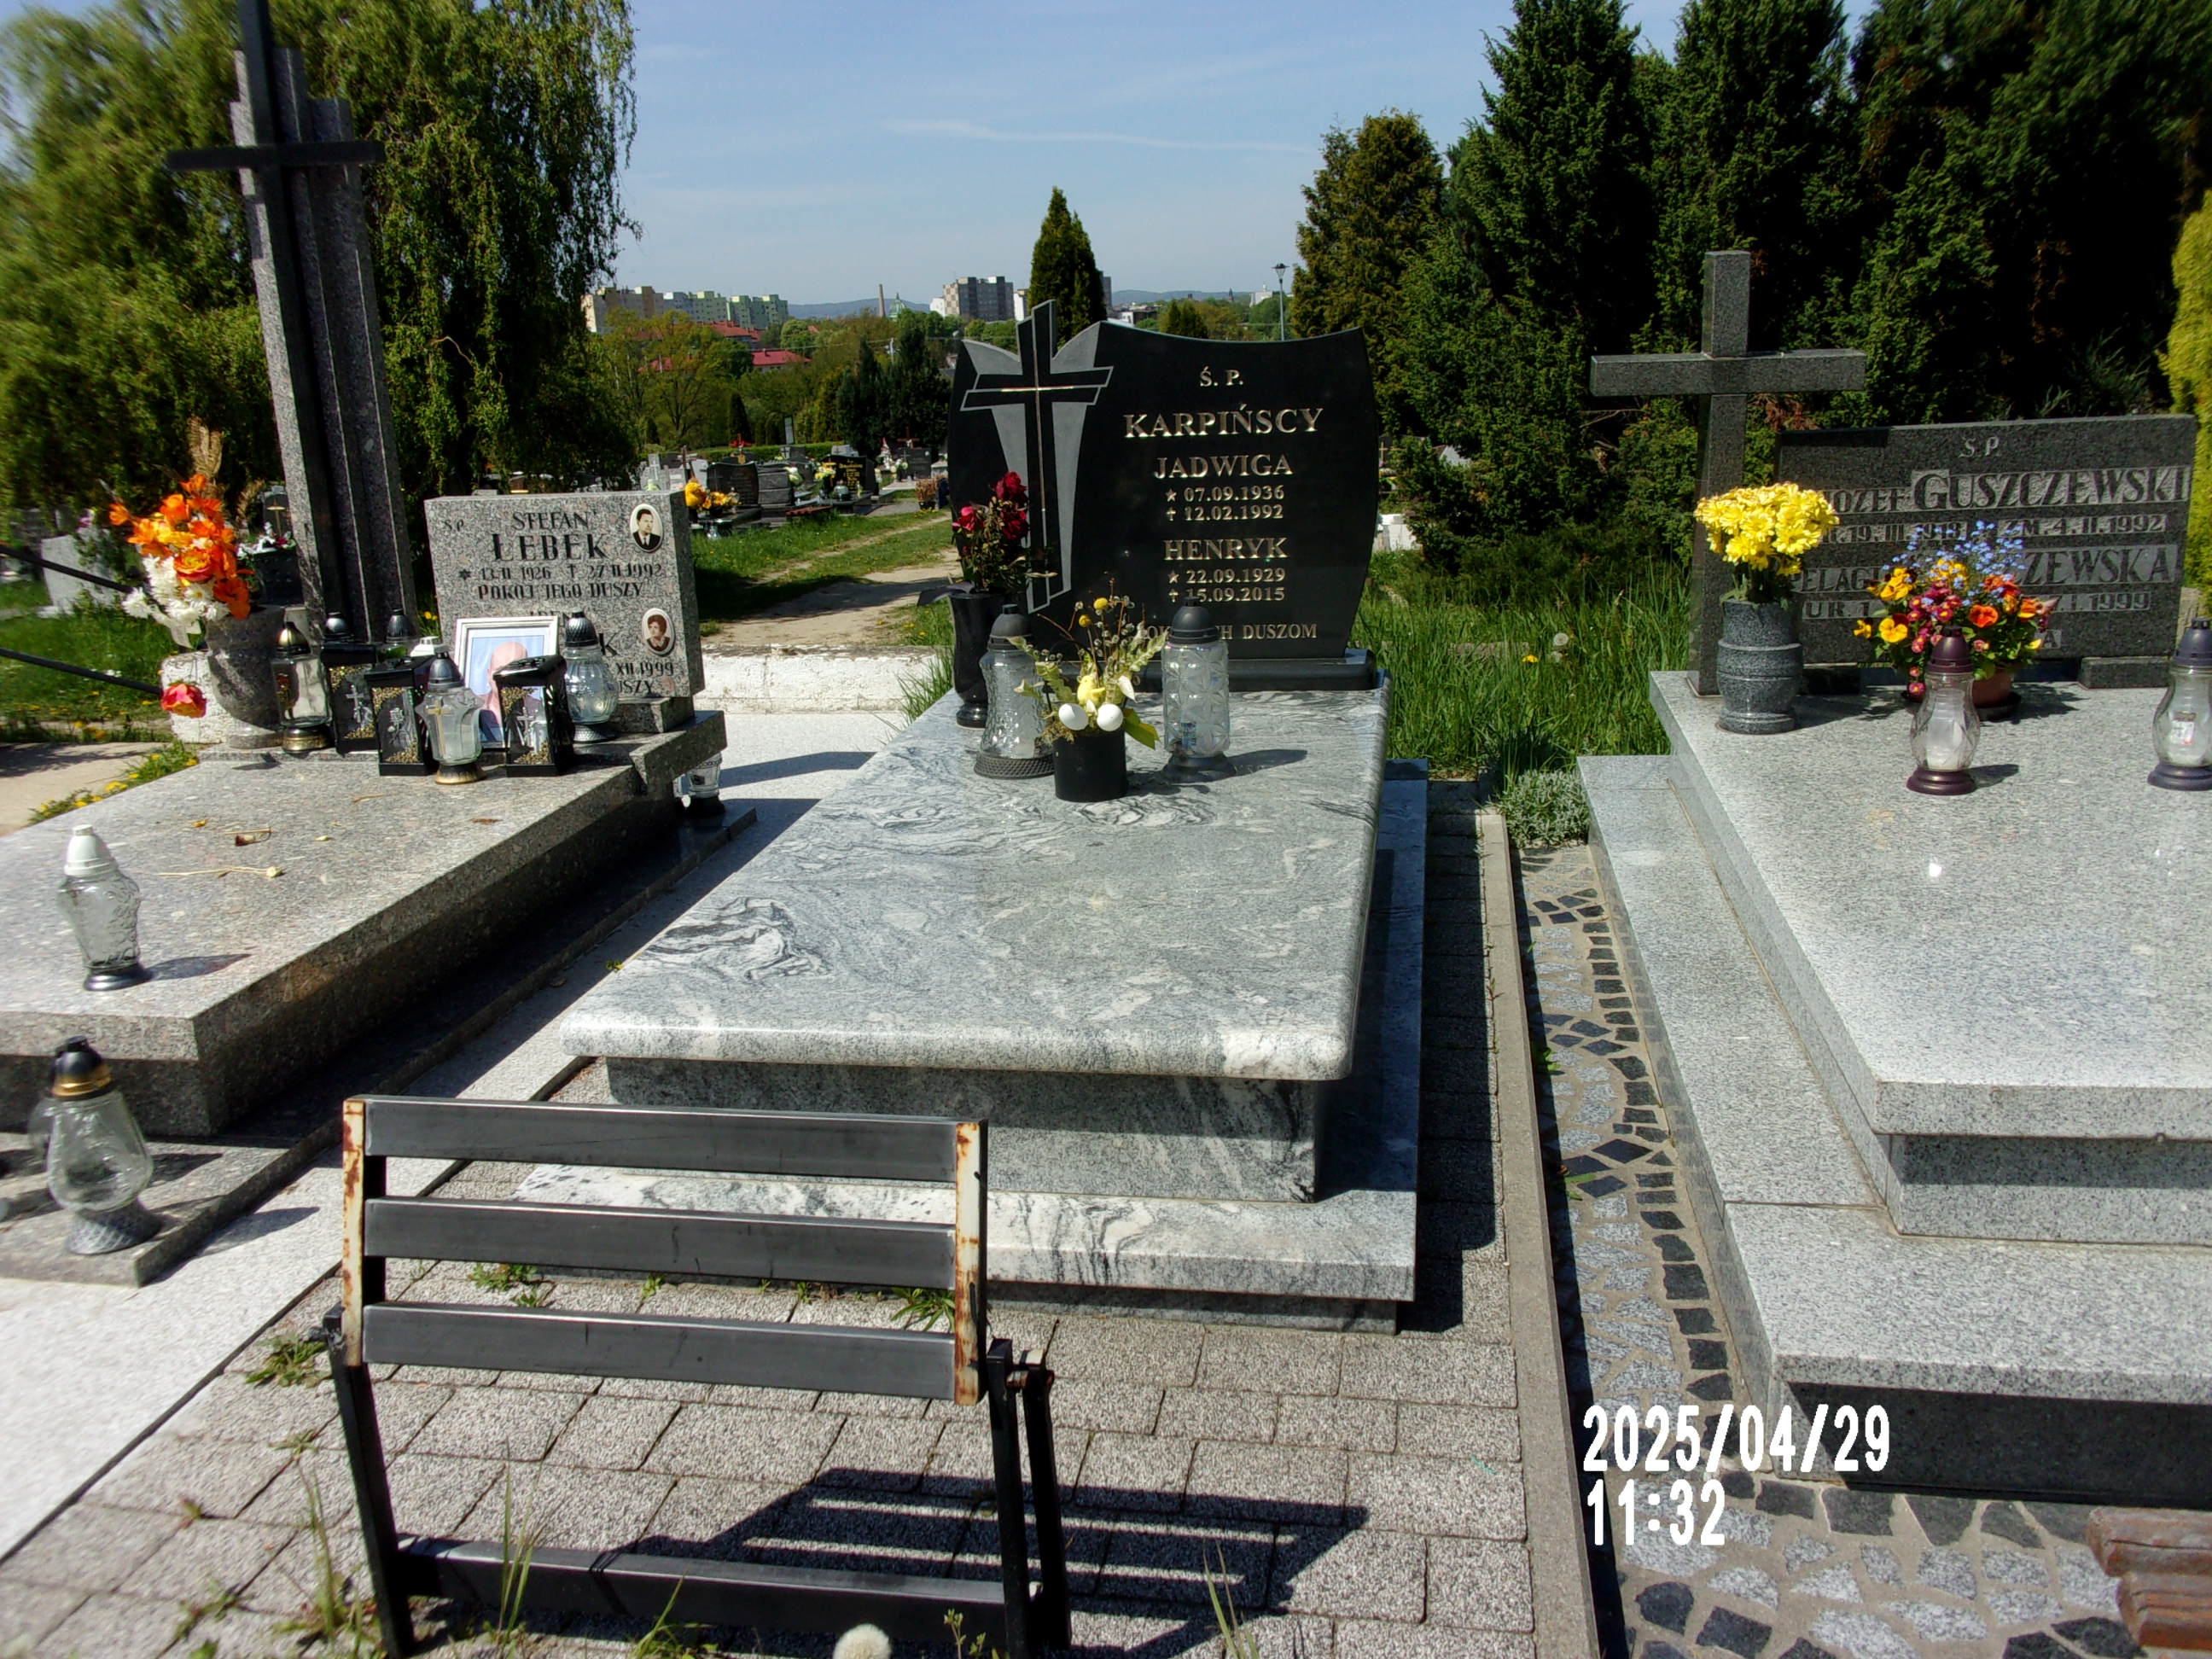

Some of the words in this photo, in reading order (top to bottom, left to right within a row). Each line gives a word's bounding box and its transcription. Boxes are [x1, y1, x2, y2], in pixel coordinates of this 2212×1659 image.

[1200, 366, 1219, 387] Ś.
[1225, 370, 1243, 386] P.
[1123, 404, 1324, 439] KARPIŃSCY
[1154, 454, 1294, 479] JADWIGA
[1184, 486, 1285, 503] 07.09.1936
[1913, 469, 2188, 510] GUSZCZEWSKI
[512, 512, 589, 530] STEFAN
[1185, 504, 1284, 521] 12.02.1992
[490, 533, 609, 562] ŁEBEK
[1163, 538, 1289, 561] HENRYK
[1186, 568, 1286, 584] 22.09.1929
[543, 584, 582, 598] JEGO
[589, 582, 643, 598] DUSZY
[1186, 587, 1285, 602] 15.09.2015
[1243, 624, 1318, 640] DUSZOM
[640, 661, 674, 677] 1999
